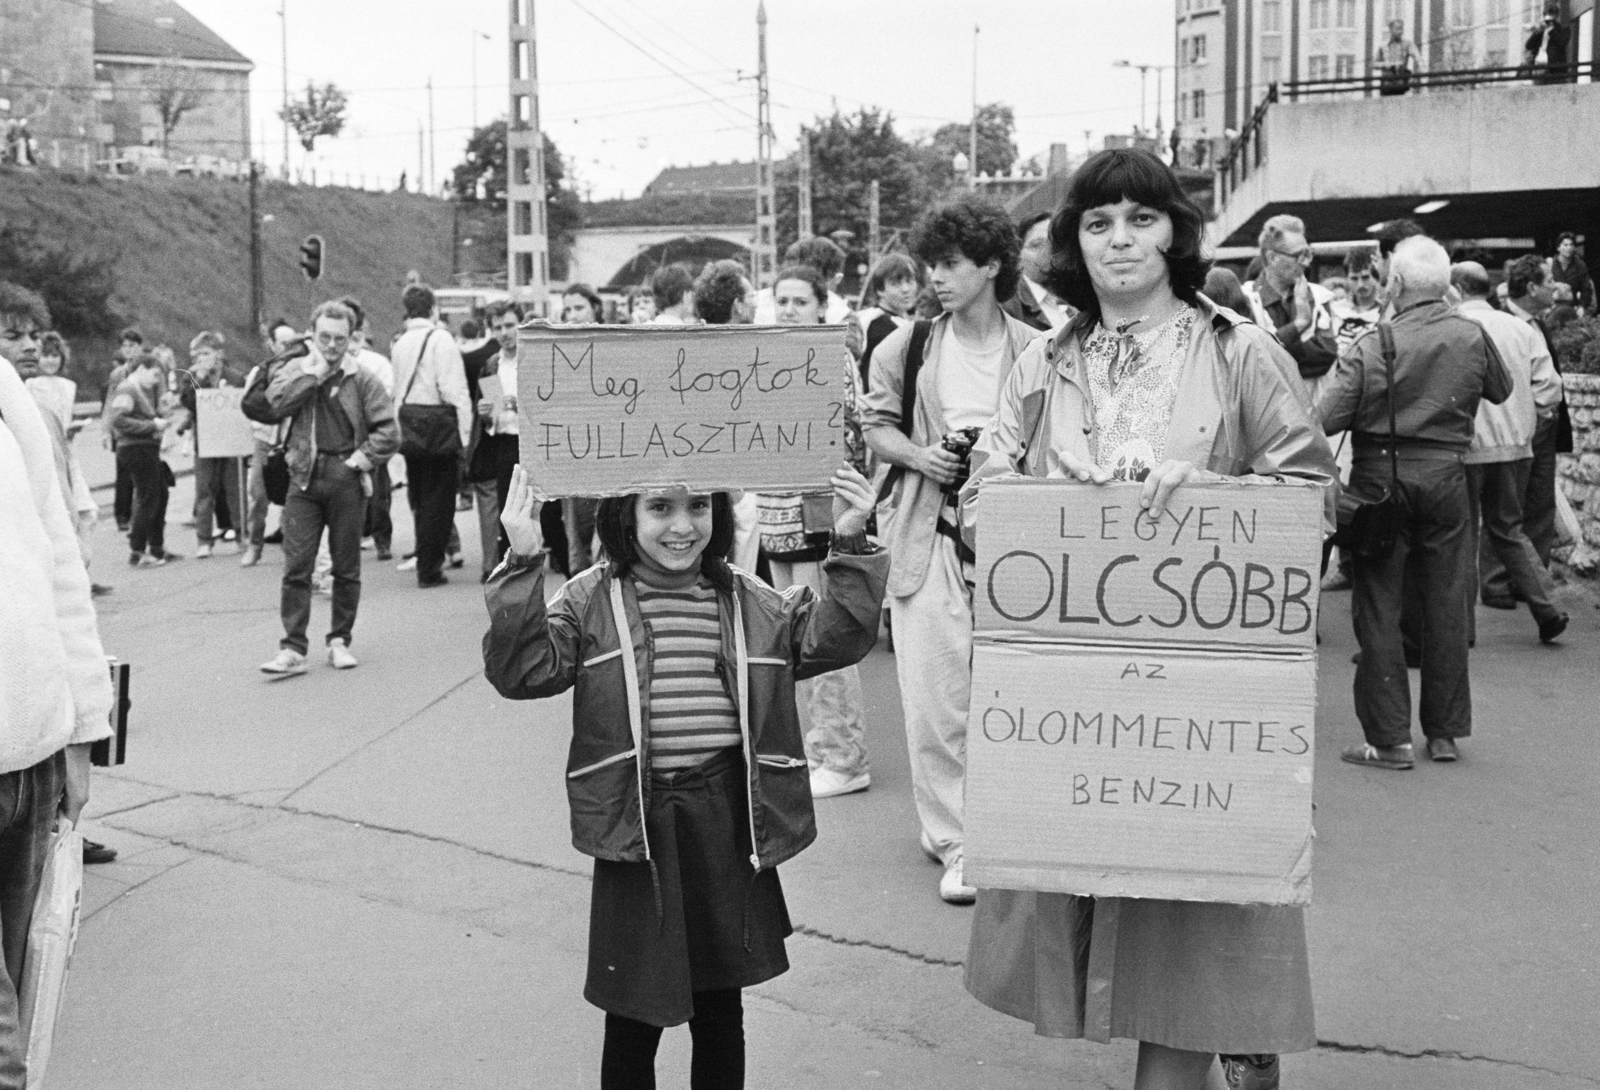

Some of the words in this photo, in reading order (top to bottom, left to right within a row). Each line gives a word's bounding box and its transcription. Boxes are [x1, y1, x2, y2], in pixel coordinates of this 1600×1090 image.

[537, 341, 645, 415] Meg
[668, 347, 829, 411] fogtok
[536, 401, 843, 461] FULLASZTANI?
[1060, 505, 1258, 546] LEGYEN
[986, 544, 1313, 635] OLCSÓBB
[1120, 661, 1167, 680] AZ
[982, 689, 1310, 755] ÓLOMMENTES
[1071, 773, 1234, 811] BENZIN
